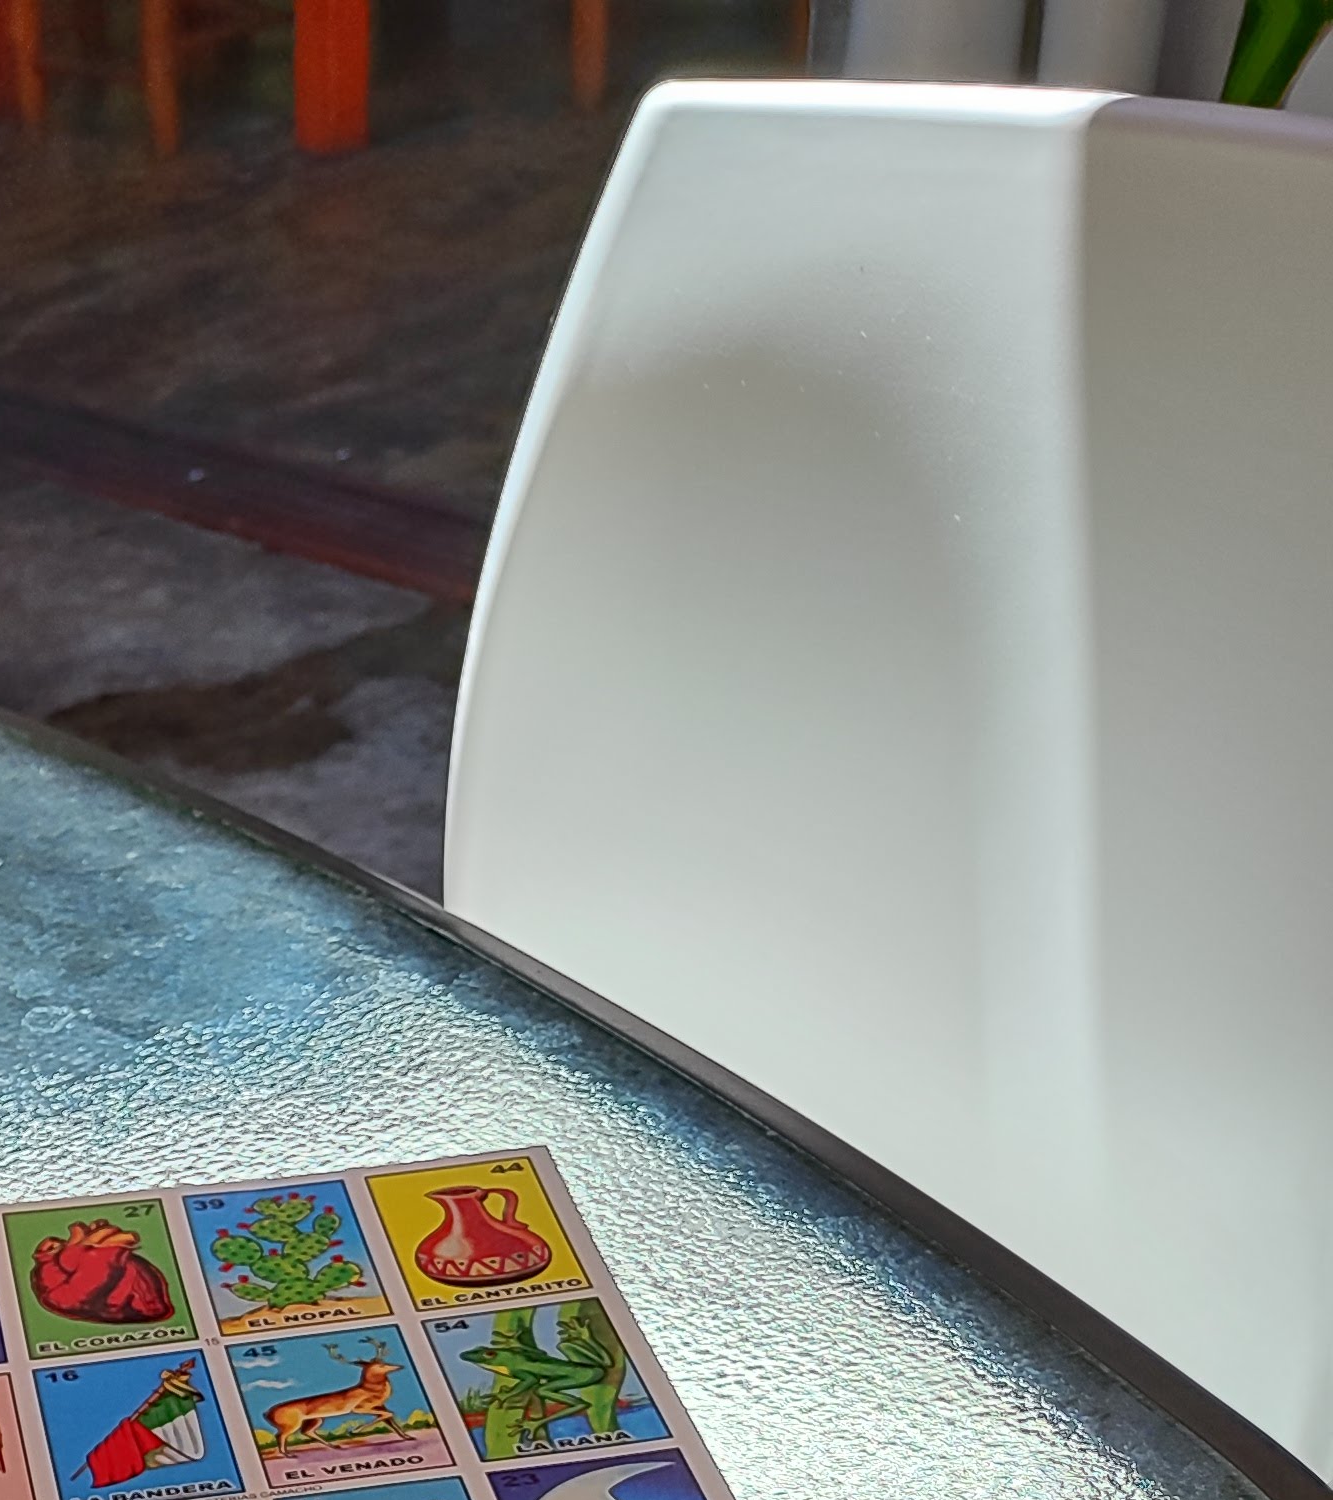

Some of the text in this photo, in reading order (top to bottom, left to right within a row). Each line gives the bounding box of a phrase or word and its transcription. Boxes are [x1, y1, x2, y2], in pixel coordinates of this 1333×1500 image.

[490, 1161, 525, 1174] 44
[123, 1204, 155, 1218] 27
[192, 1198, 225, 1212] 39
[420, 1278, 583, 1307] EL CANTARITO
[247, 1306, 362, 1328] EL NOPAL
[434, 1319, 470, 1333] 54
[38, 1343, 65, 1353] EL
[243, 1345, 278, 1359] 45
[44, 1369, 80, 1384] 16
[515, 1430, 632, 1453] LA RANA
[284, 1454, 424, 1481] EL VENADO
[500, 1473, 541, 1488] 23
[259, 1484, 323, 1498] CAMACHO
